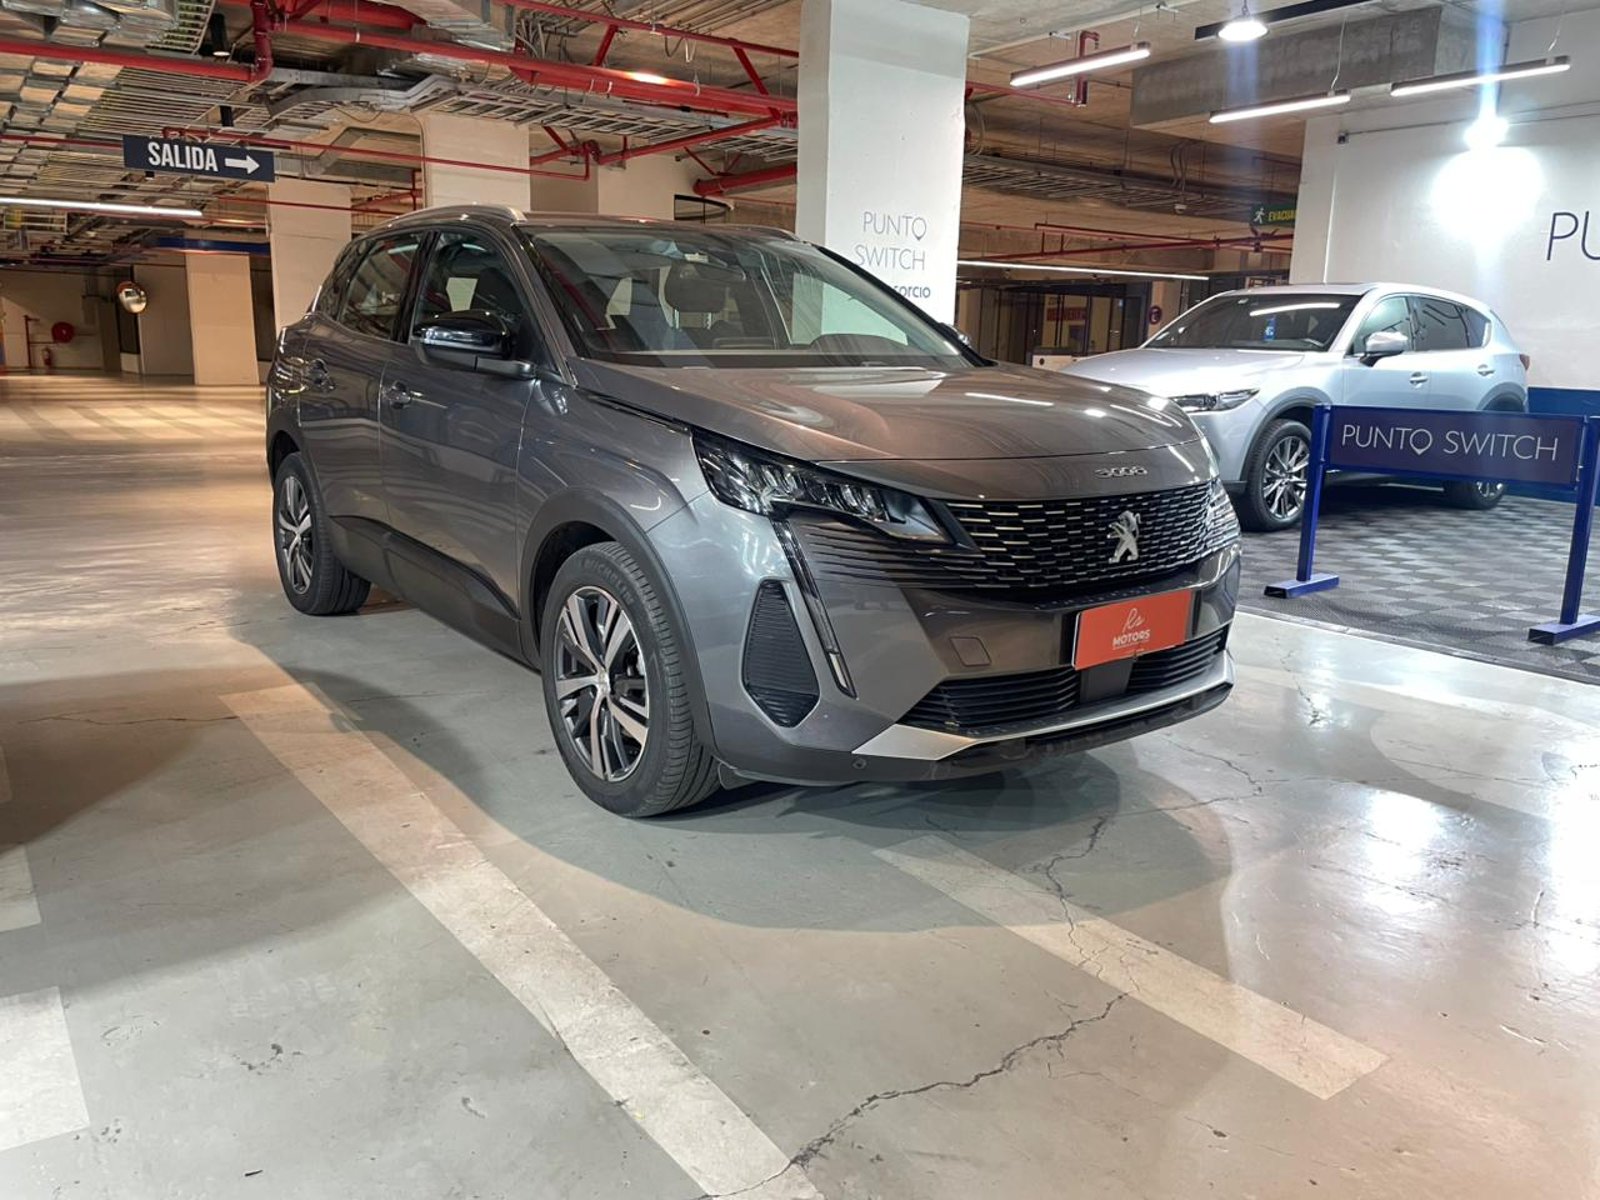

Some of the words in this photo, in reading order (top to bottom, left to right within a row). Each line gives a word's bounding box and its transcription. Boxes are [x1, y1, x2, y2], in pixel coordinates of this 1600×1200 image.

[148, 142, 218, 172] SALIDA
[863, 211, 927, 241] PUNTO
[855, 244, 925, 271] SWITCH
[894, 285, 931, 299] orcio
[1341, 424, 1433, 456] PUNTO
[1443, 430, 1559, 462] SWITCH
[1112, 629, 1151, 647] MOTORS
